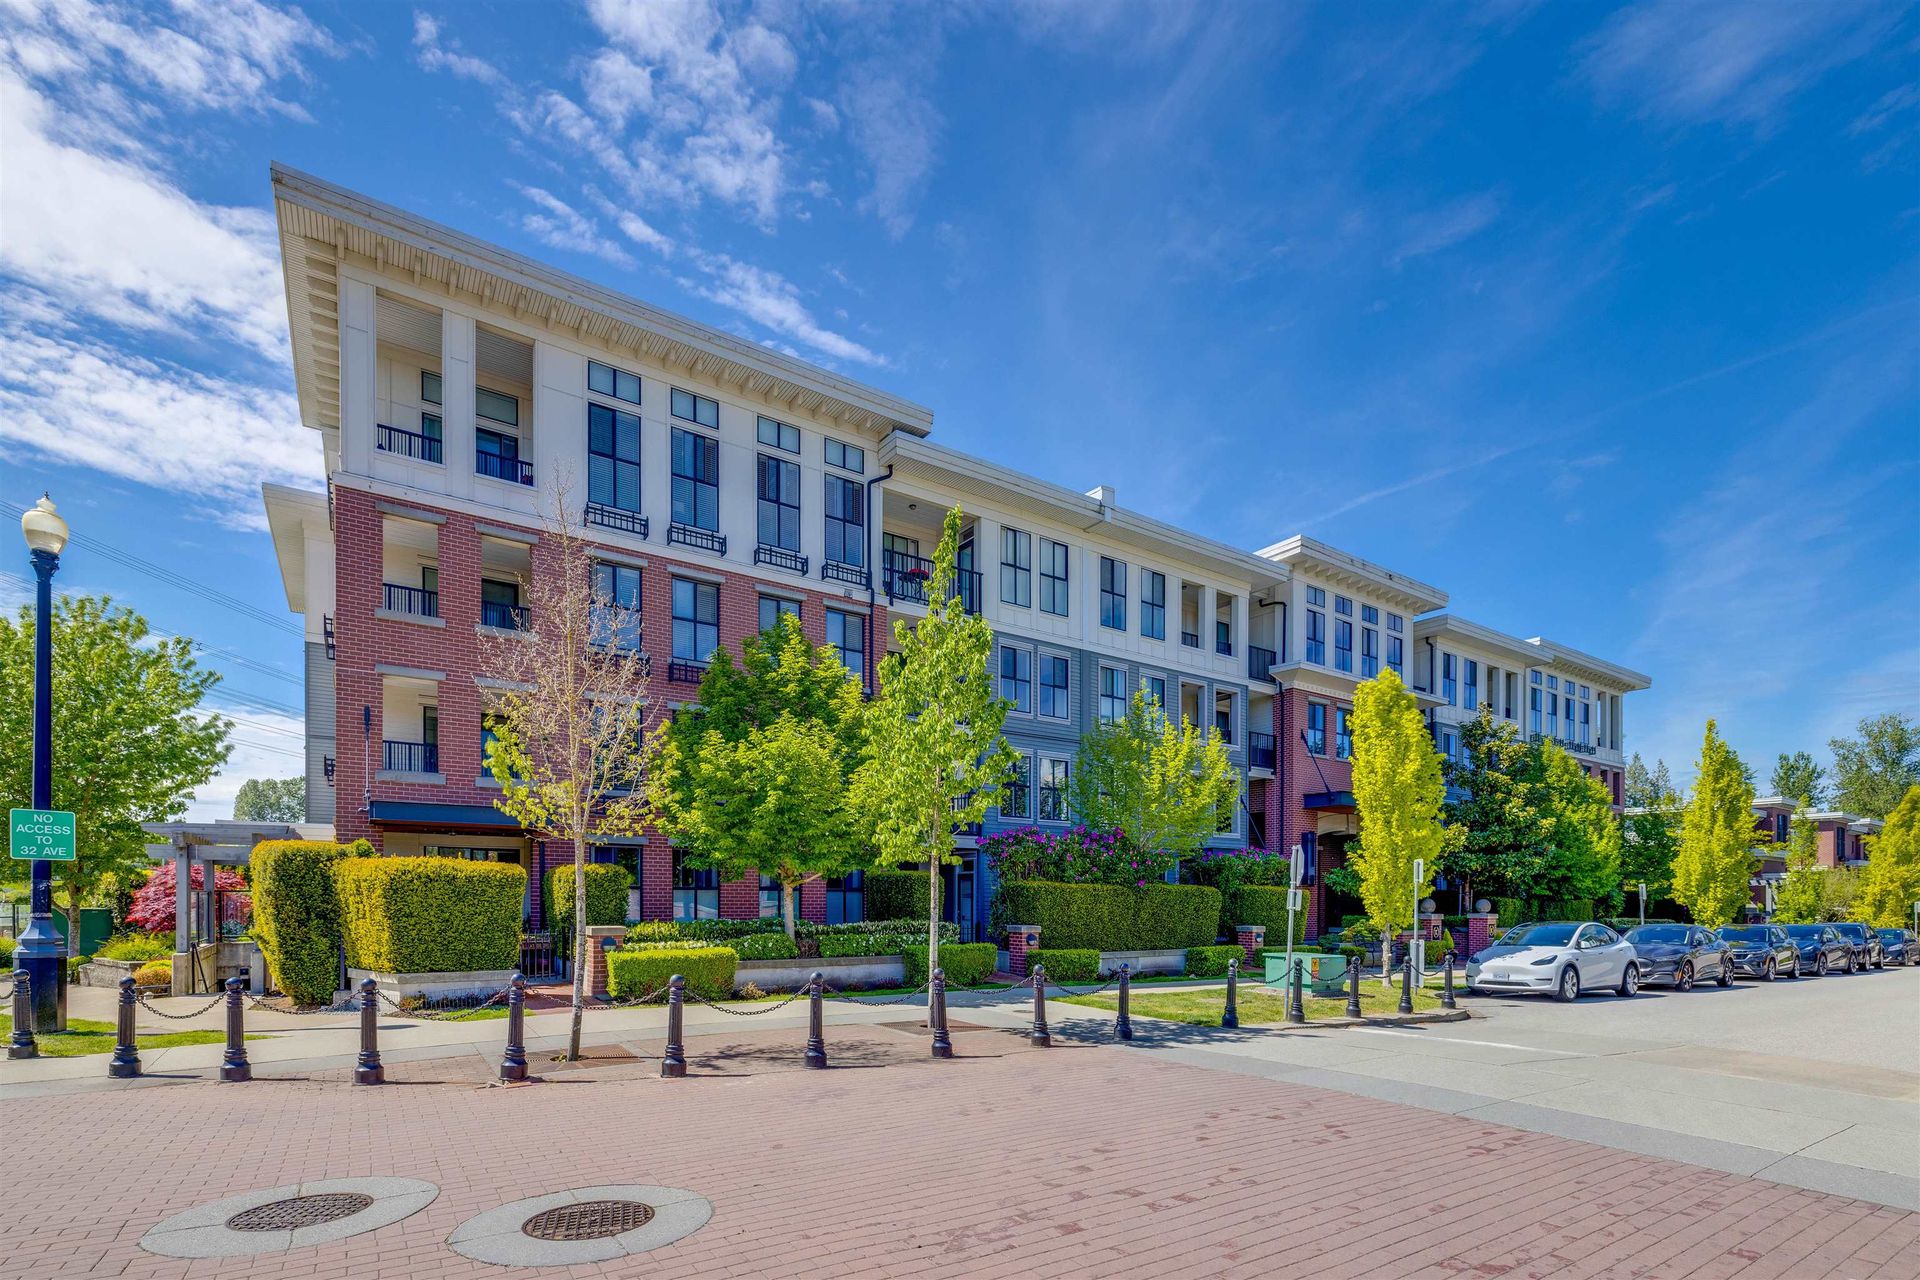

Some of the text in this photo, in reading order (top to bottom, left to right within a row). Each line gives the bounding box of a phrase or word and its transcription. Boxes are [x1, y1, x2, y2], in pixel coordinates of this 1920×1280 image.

[34, 814, 53, 823] NO
[16, 824, 71, 835] ACCESS
[35, 836, 53, 845] TO
[20, 846, 67, 856] 32 AVE
